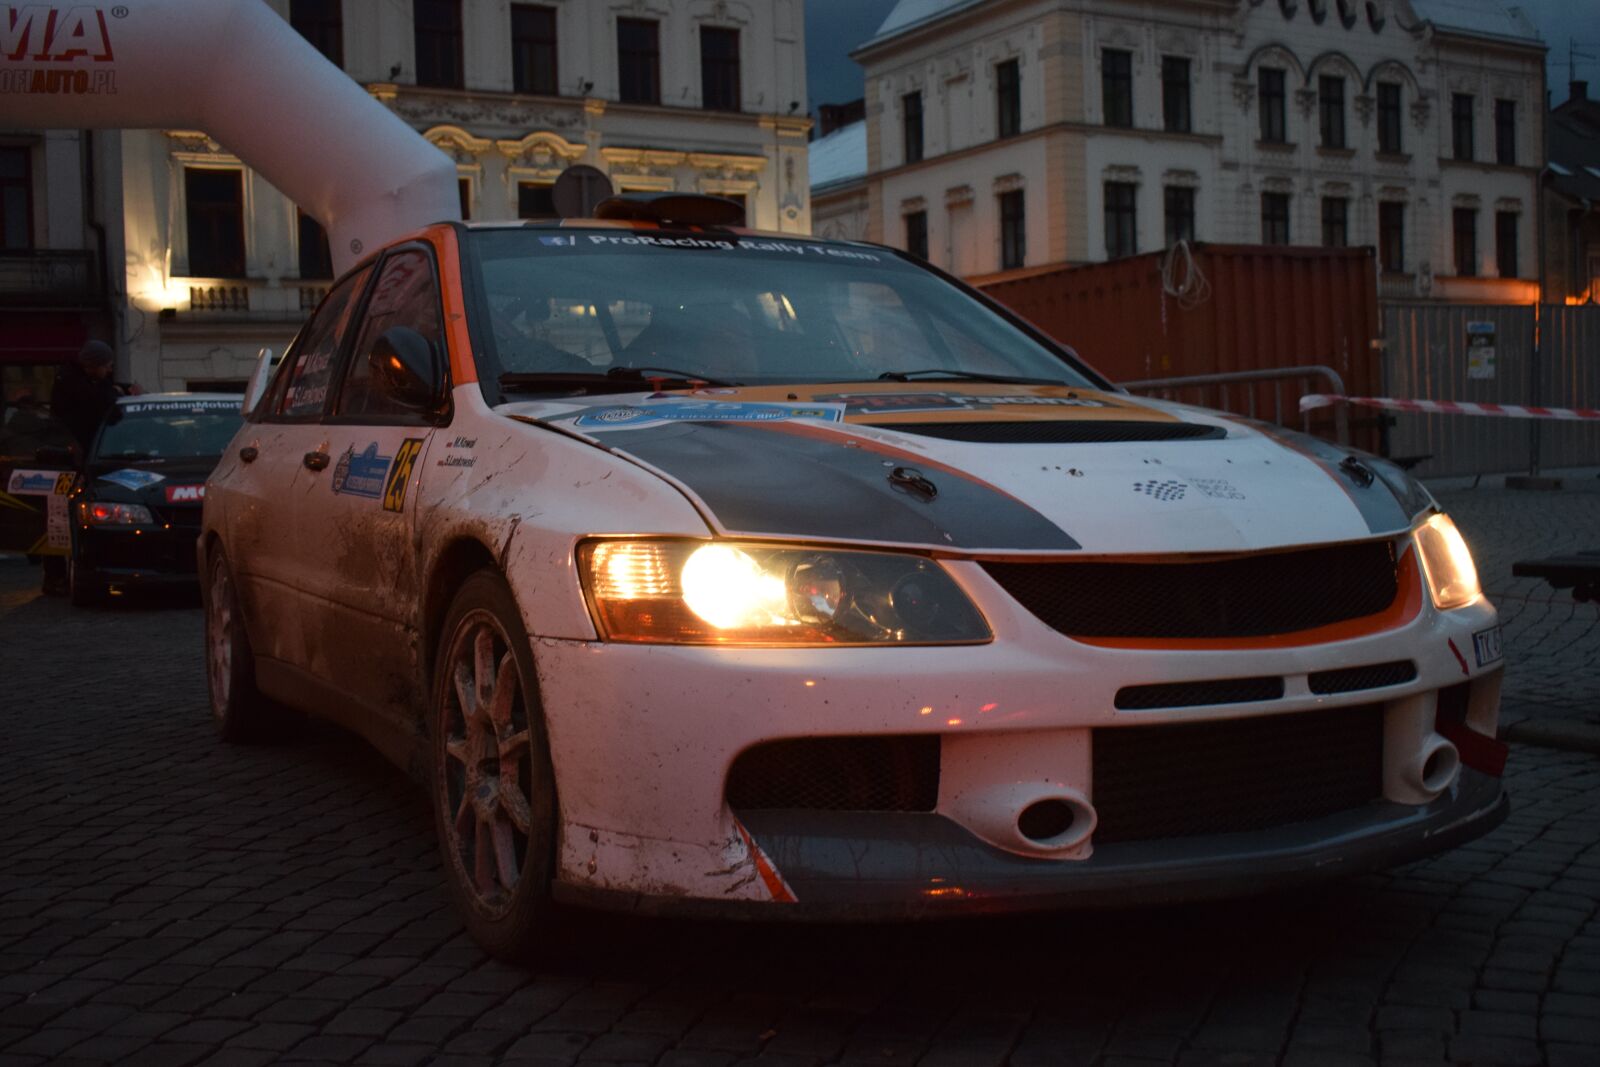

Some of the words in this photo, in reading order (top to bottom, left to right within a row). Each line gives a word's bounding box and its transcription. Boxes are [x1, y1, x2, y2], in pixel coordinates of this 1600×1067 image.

[588, 234, 734, 250] ProRacing
[737, 240, 804, 255] Rally
[806, 245, 881, 262] Team
[384, 440, 422, 512] 25
